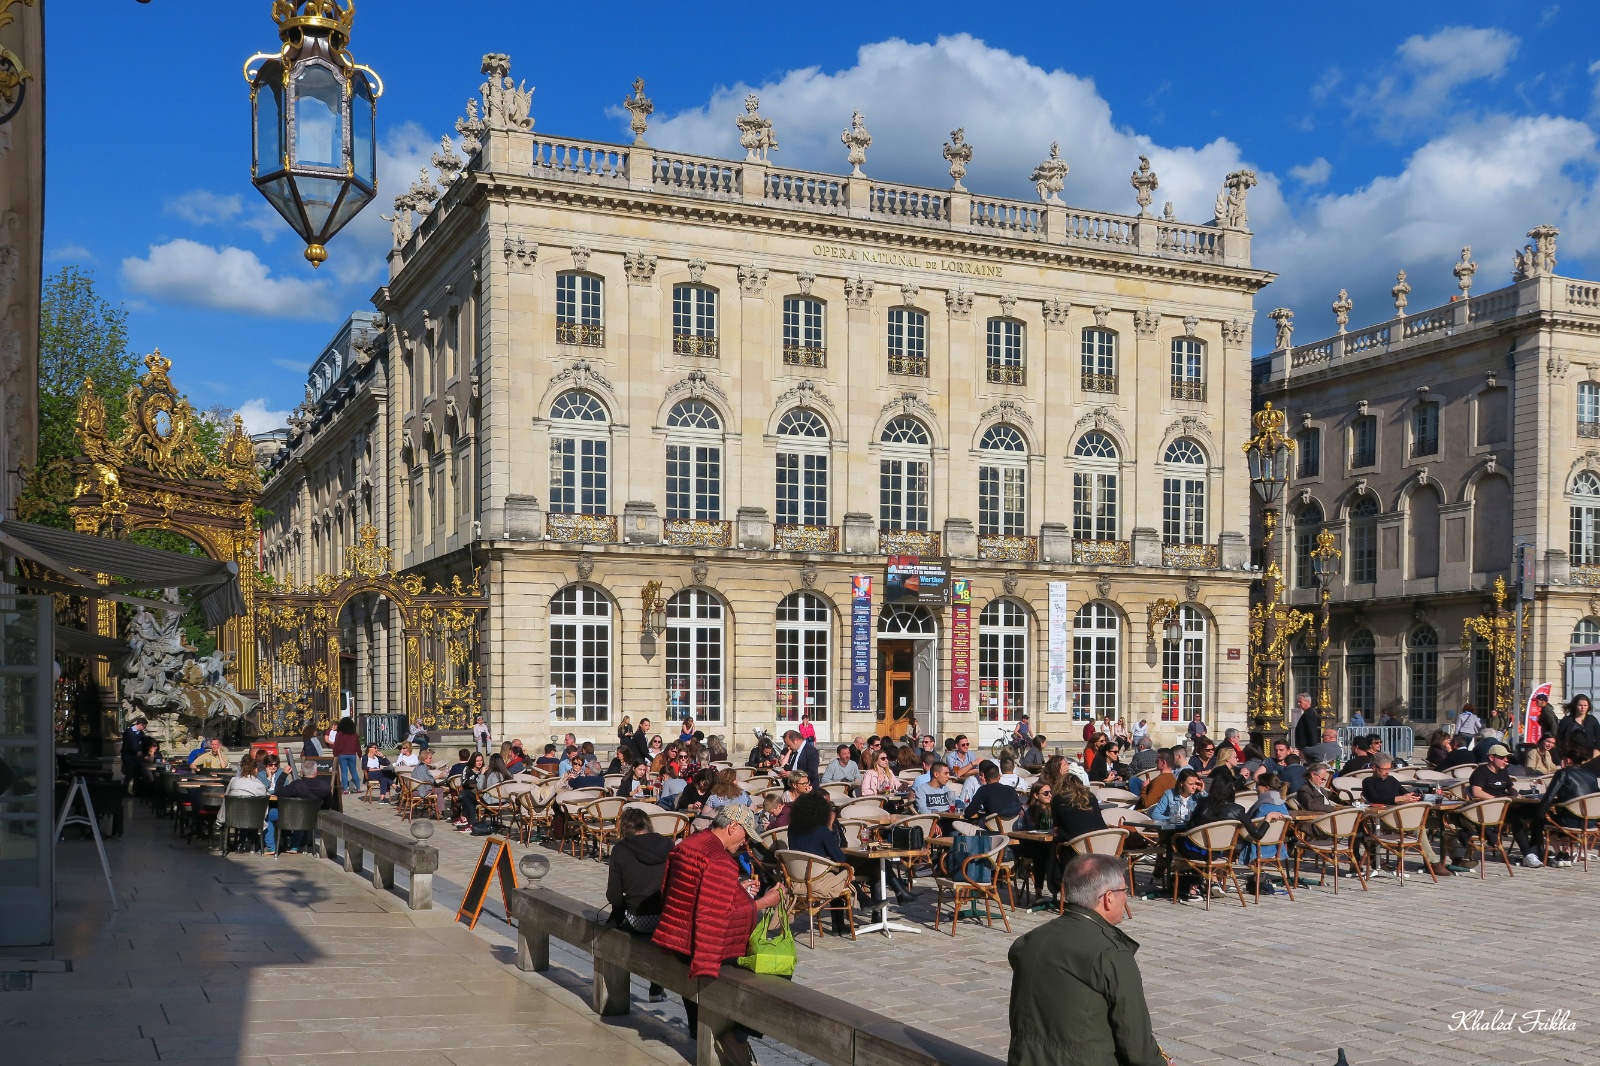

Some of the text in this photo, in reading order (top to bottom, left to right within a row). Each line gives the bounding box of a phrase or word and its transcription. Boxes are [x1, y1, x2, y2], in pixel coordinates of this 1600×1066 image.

[862, 251, 921, 268] NATIONAL
[940, 260, 1003, 278] LORRAINE
[920, 575, 945, 584] Werther
[955, 581, 966, 592] 17
[960, 589, 970, 600] 18
